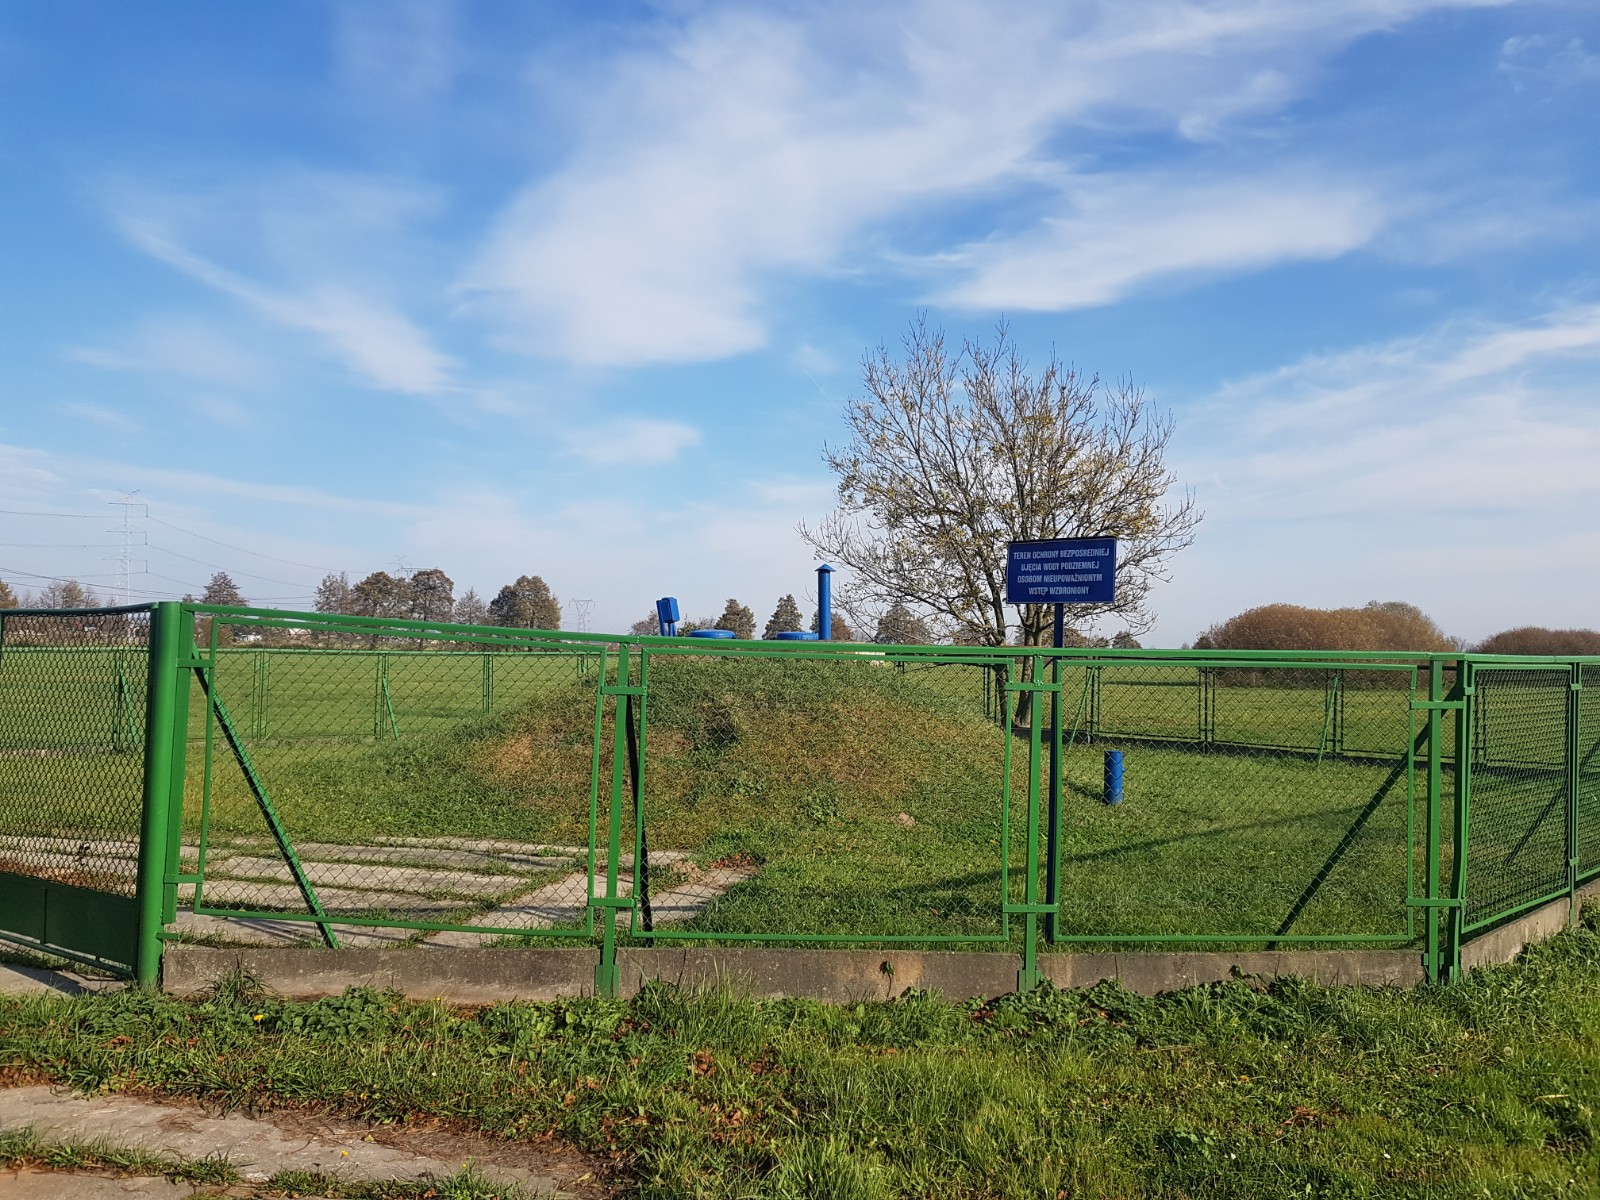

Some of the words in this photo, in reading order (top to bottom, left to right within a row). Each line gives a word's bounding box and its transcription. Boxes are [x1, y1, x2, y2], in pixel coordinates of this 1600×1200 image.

[1013, 552, 1031, 560] TEREN
[1032, 550, 1059, 559] OCHRONY
[1060, 548, 1110, 558] BEZPOŚREDNIEJ
[1021, 563, 1041, 572] UJĘCIA
[1043, 562, 1060, 571] WODY
[1060, 561, 1100, 570] PODZIEMNEJ
[1017, 575, 1042, 583] OSOBOM
[1028, 587, 1048, 596] WSTĘP
[1050, 586, 1090, 595] WZBRONIONY
